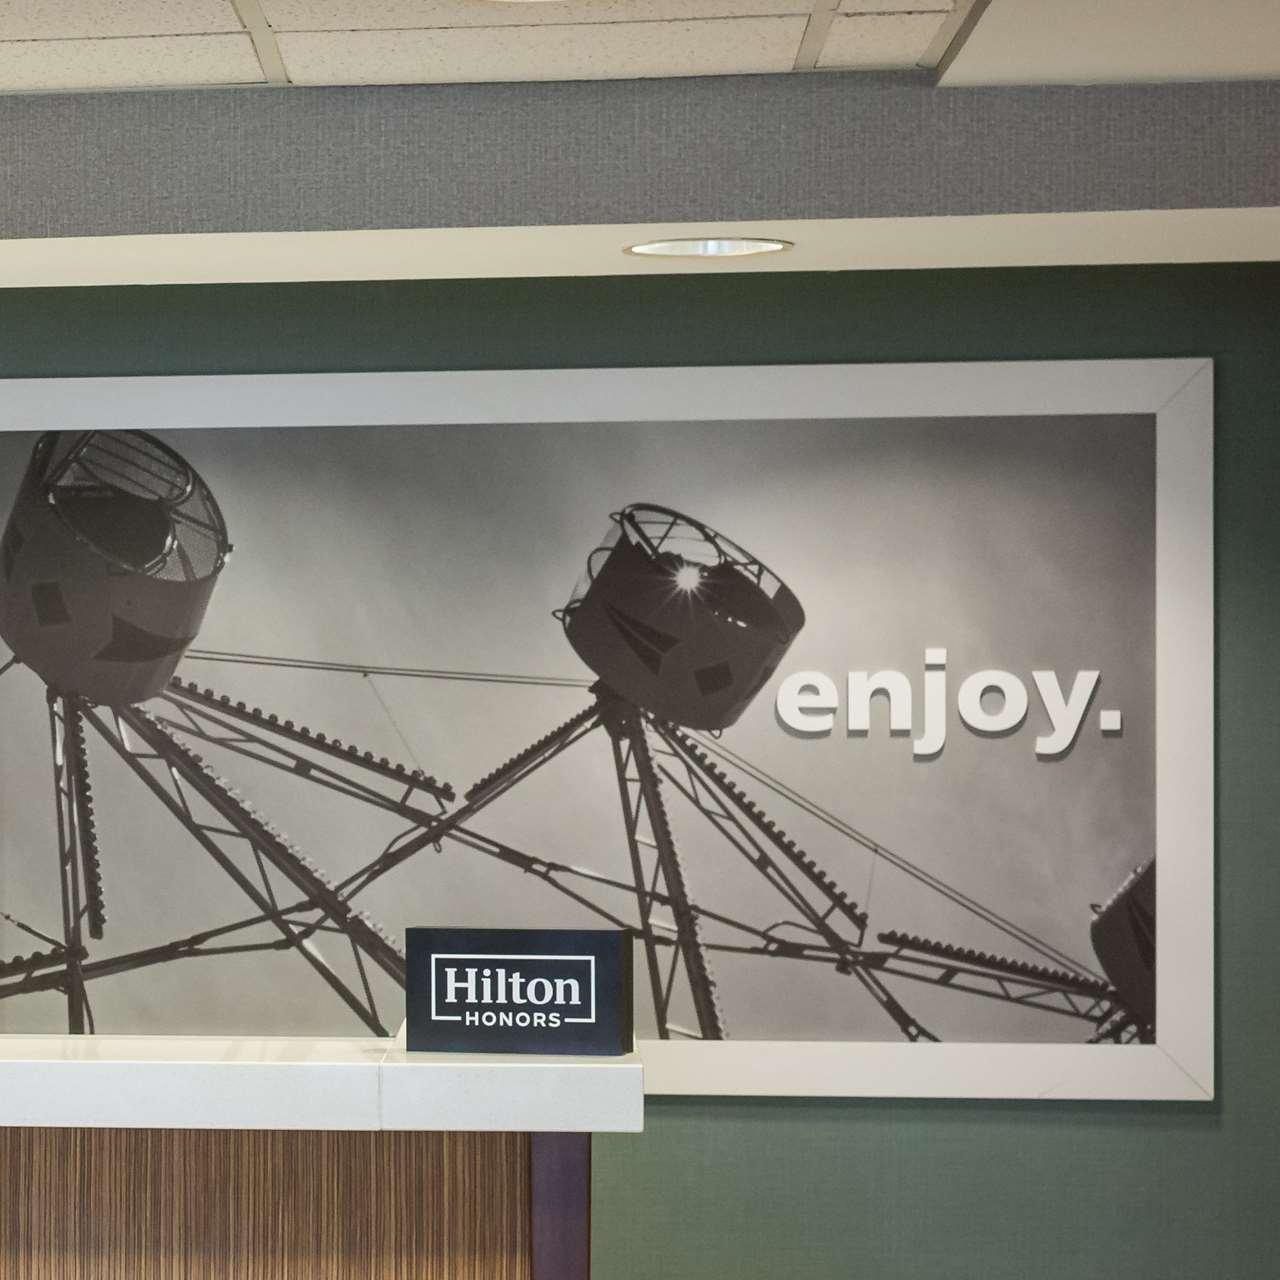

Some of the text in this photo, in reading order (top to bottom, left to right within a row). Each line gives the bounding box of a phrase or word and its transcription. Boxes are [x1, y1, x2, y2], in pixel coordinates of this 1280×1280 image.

[776, 647, 1123, 756] enjoy.
[444, 967, 582, 1005] Hilton
[465, 1011, 561, 1028] HONORS
